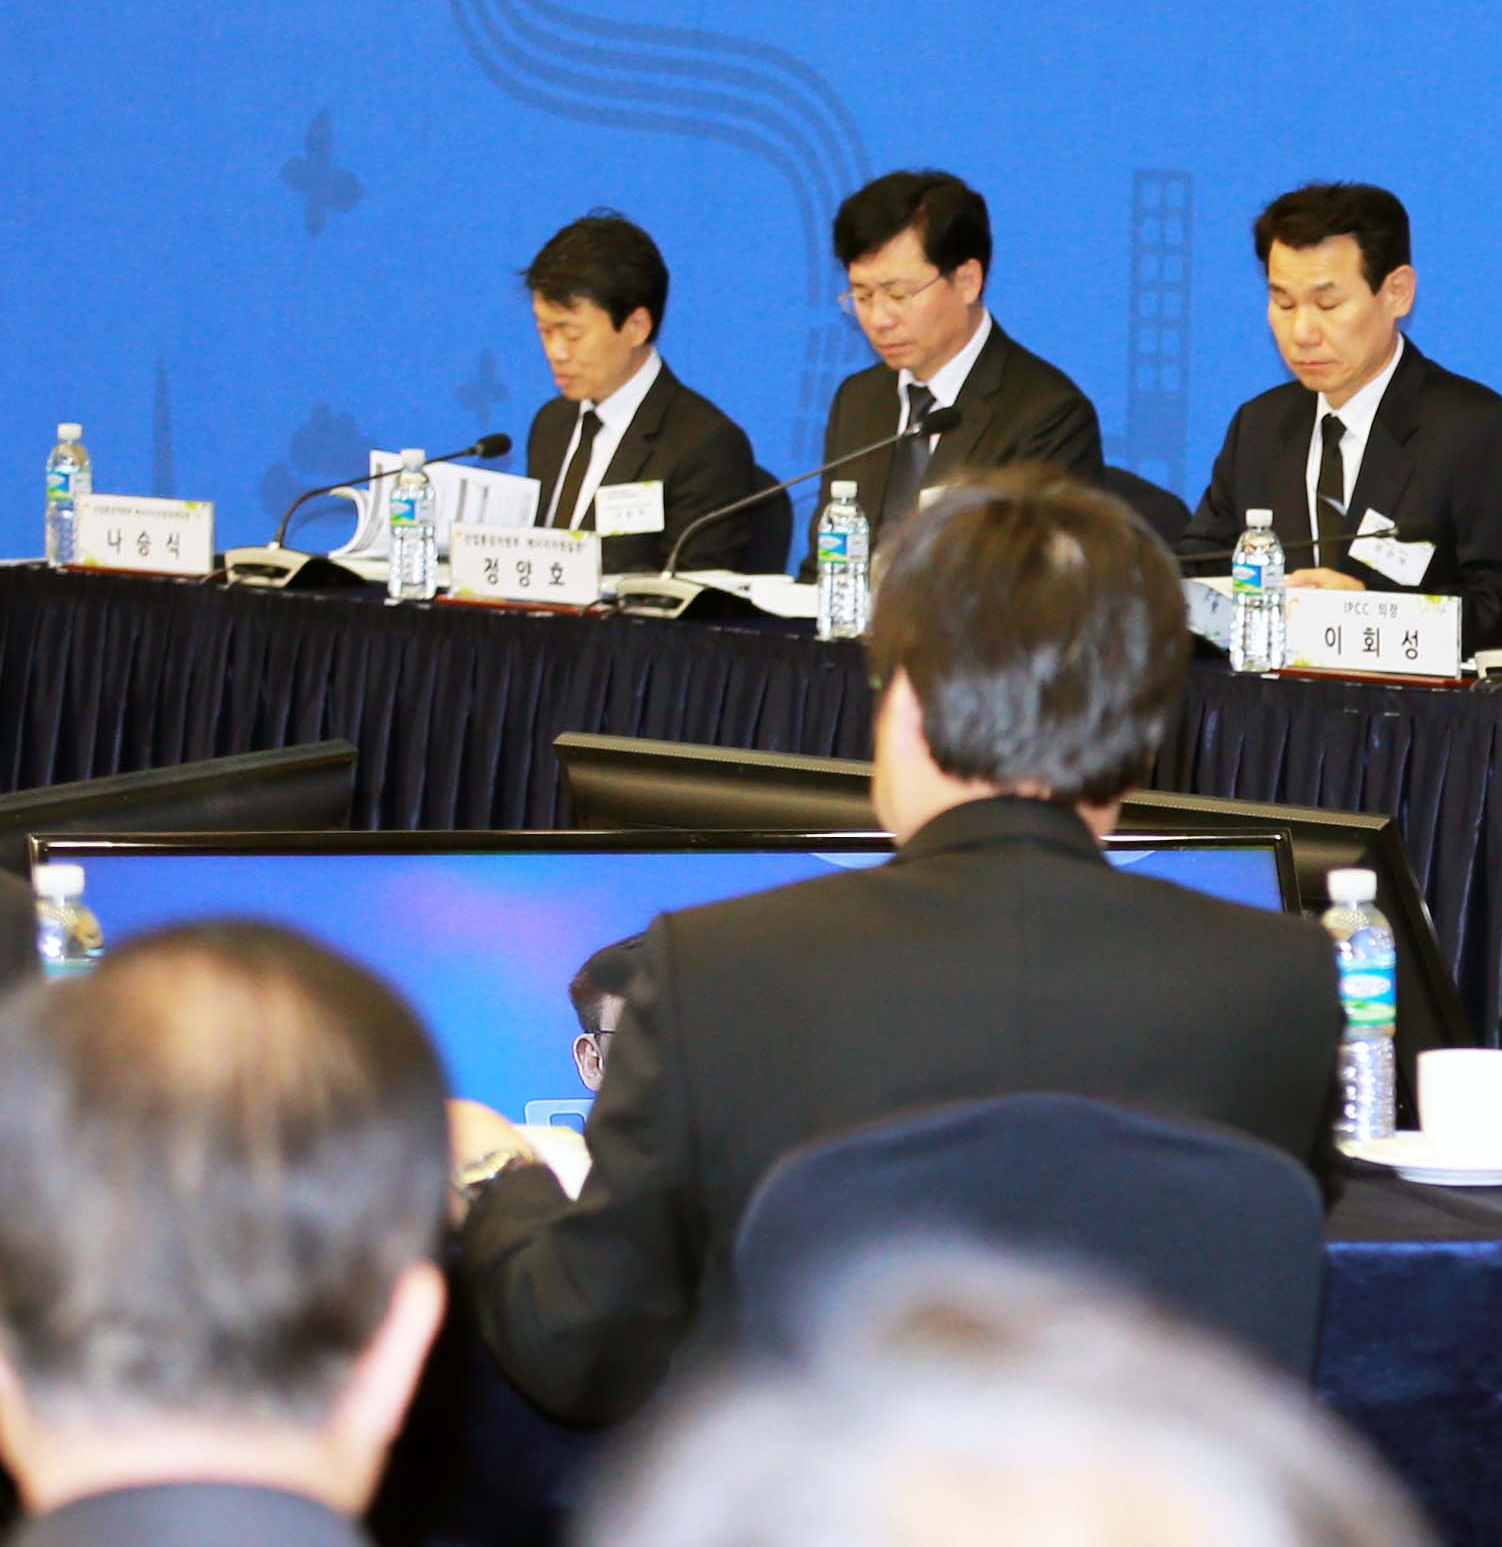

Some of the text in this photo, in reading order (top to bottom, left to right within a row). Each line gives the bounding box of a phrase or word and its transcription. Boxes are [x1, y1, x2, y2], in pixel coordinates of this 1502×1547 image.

[1343, 601, 1369, 616] IPCC
[1324, 625, 1419, 660] 이 회 성
